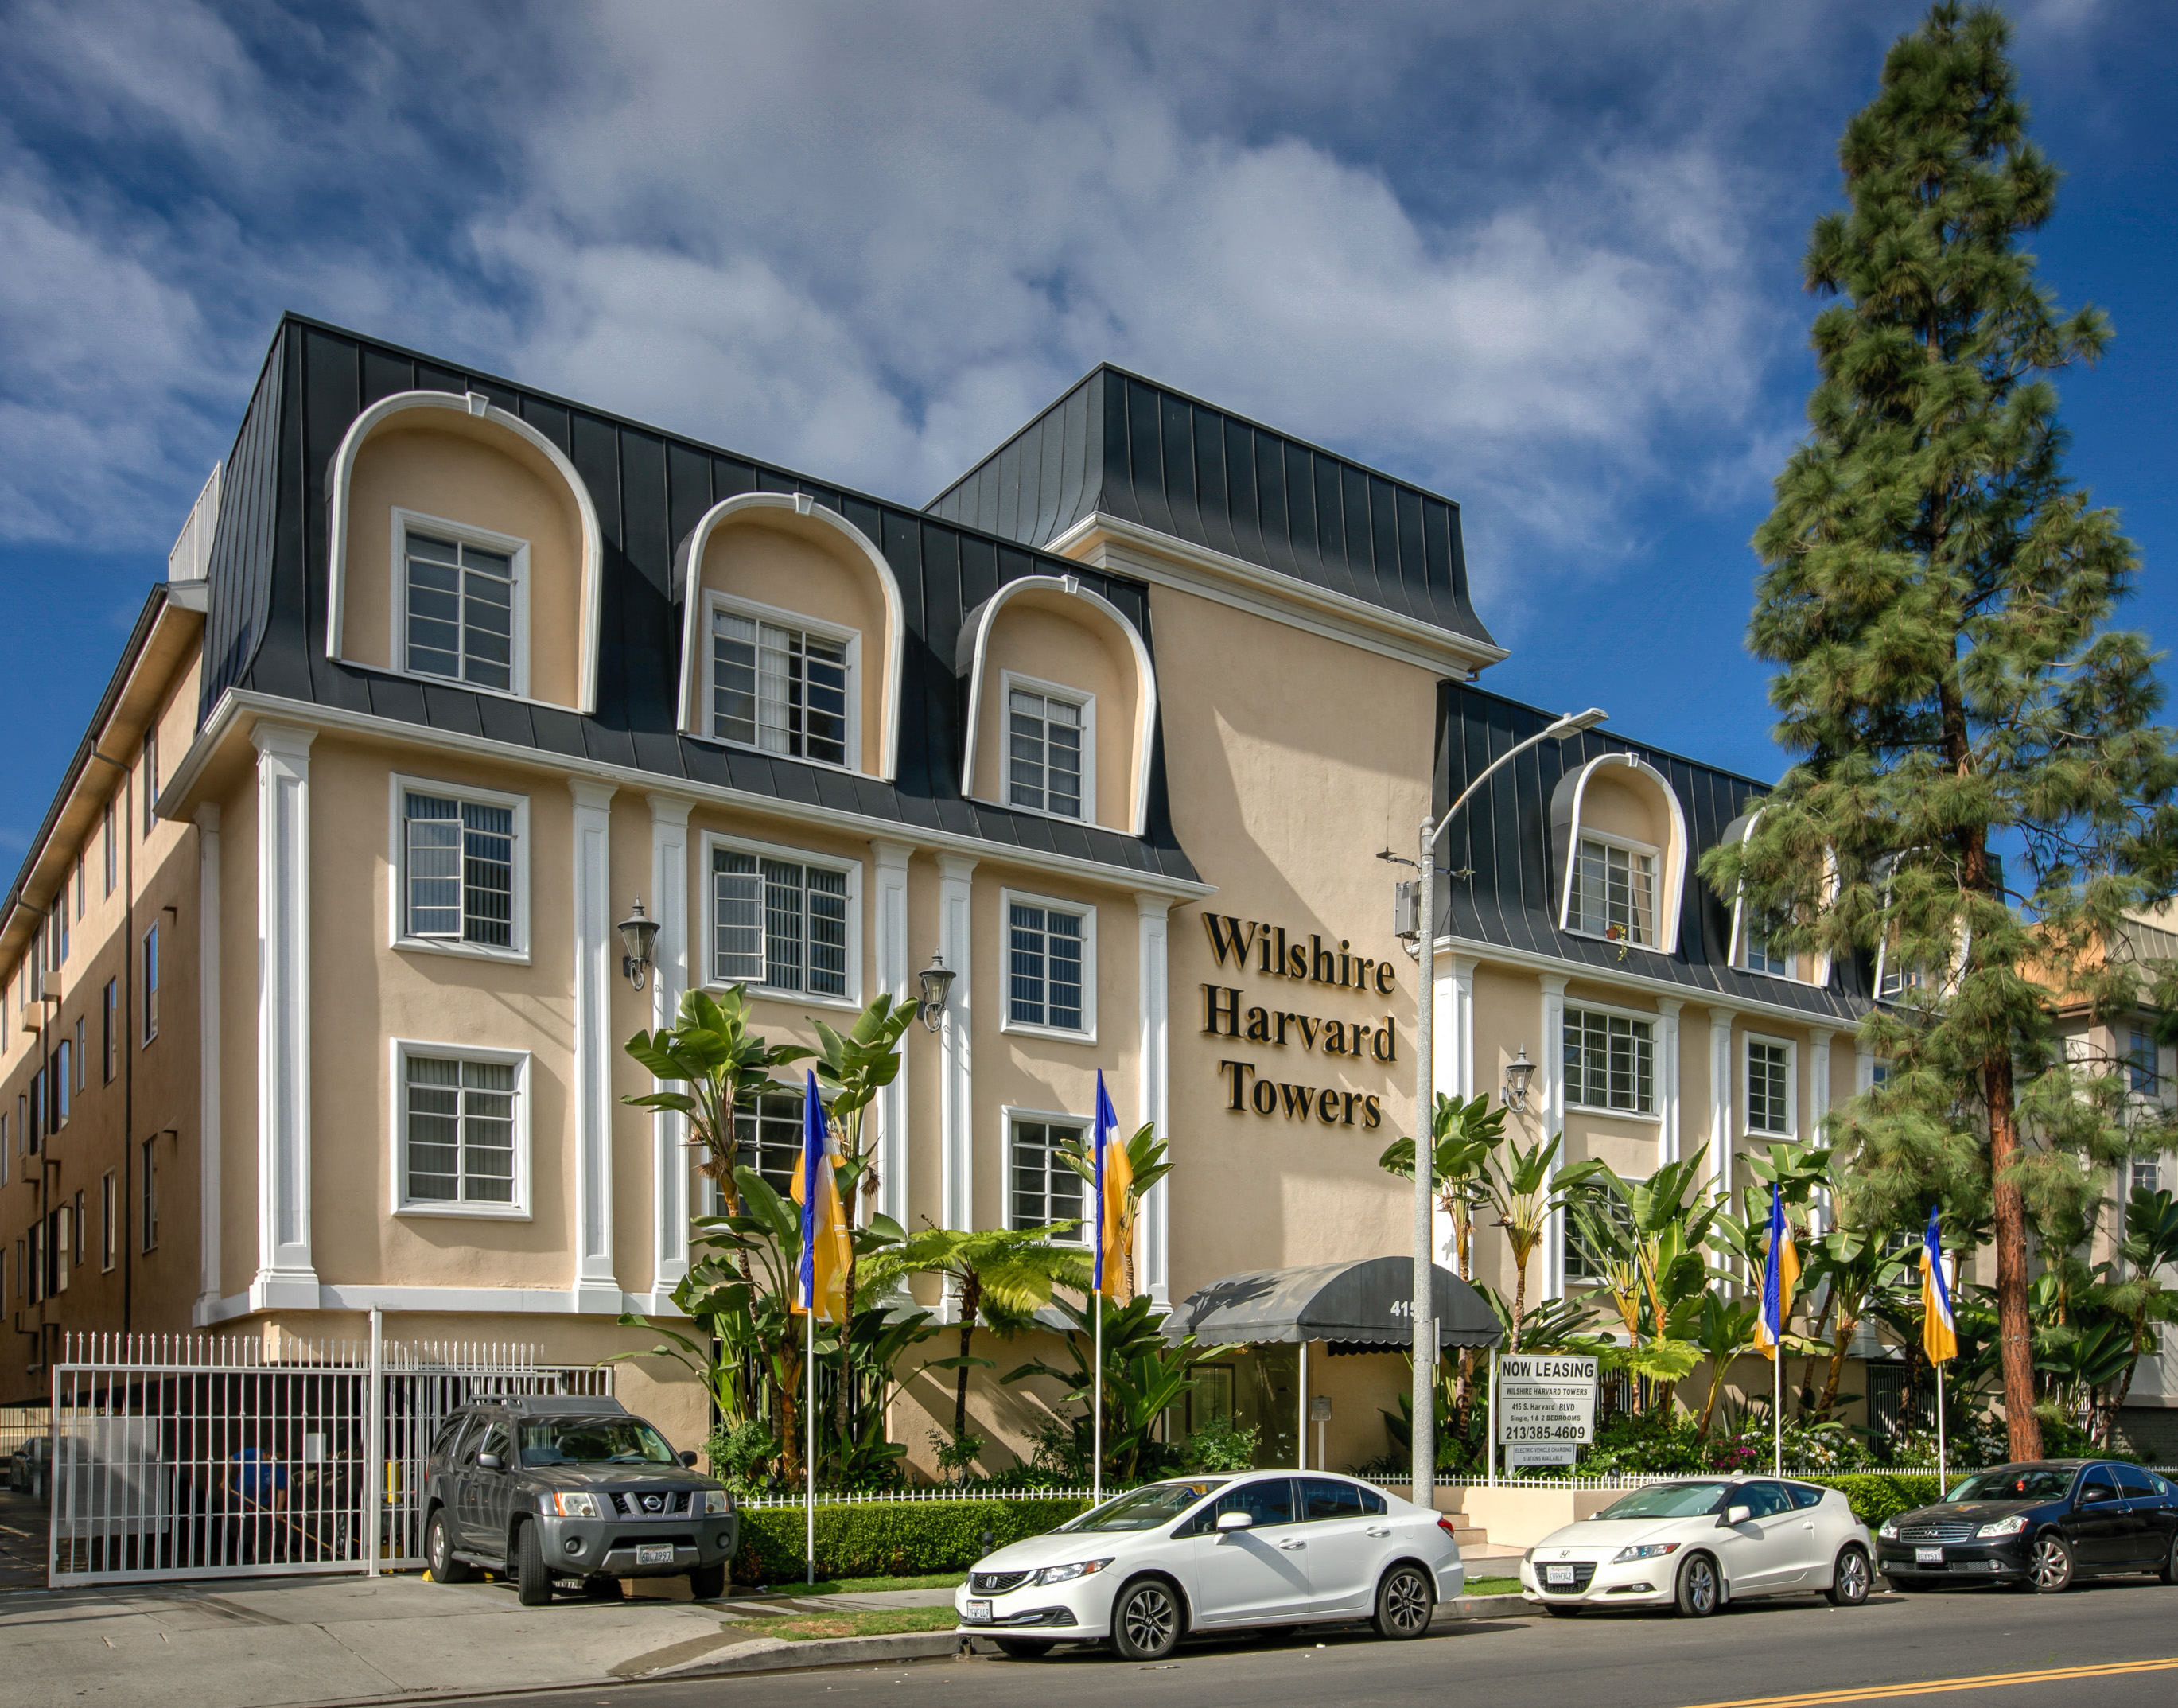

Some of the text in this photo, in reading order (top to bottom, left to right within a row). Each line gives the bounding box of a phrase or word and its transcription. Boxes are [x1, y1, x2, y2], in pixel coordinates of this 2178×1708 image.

[1201, 912, 1395, 995] Wilshire
[1200, 983, 1397, 1062] Harvard
[1219, 1060, 1381, 1129] Towers
[1503, 1361, 1594, 1378] NOW LEASING
[1506, 1426, 1585, 1440] 213/385-4609
